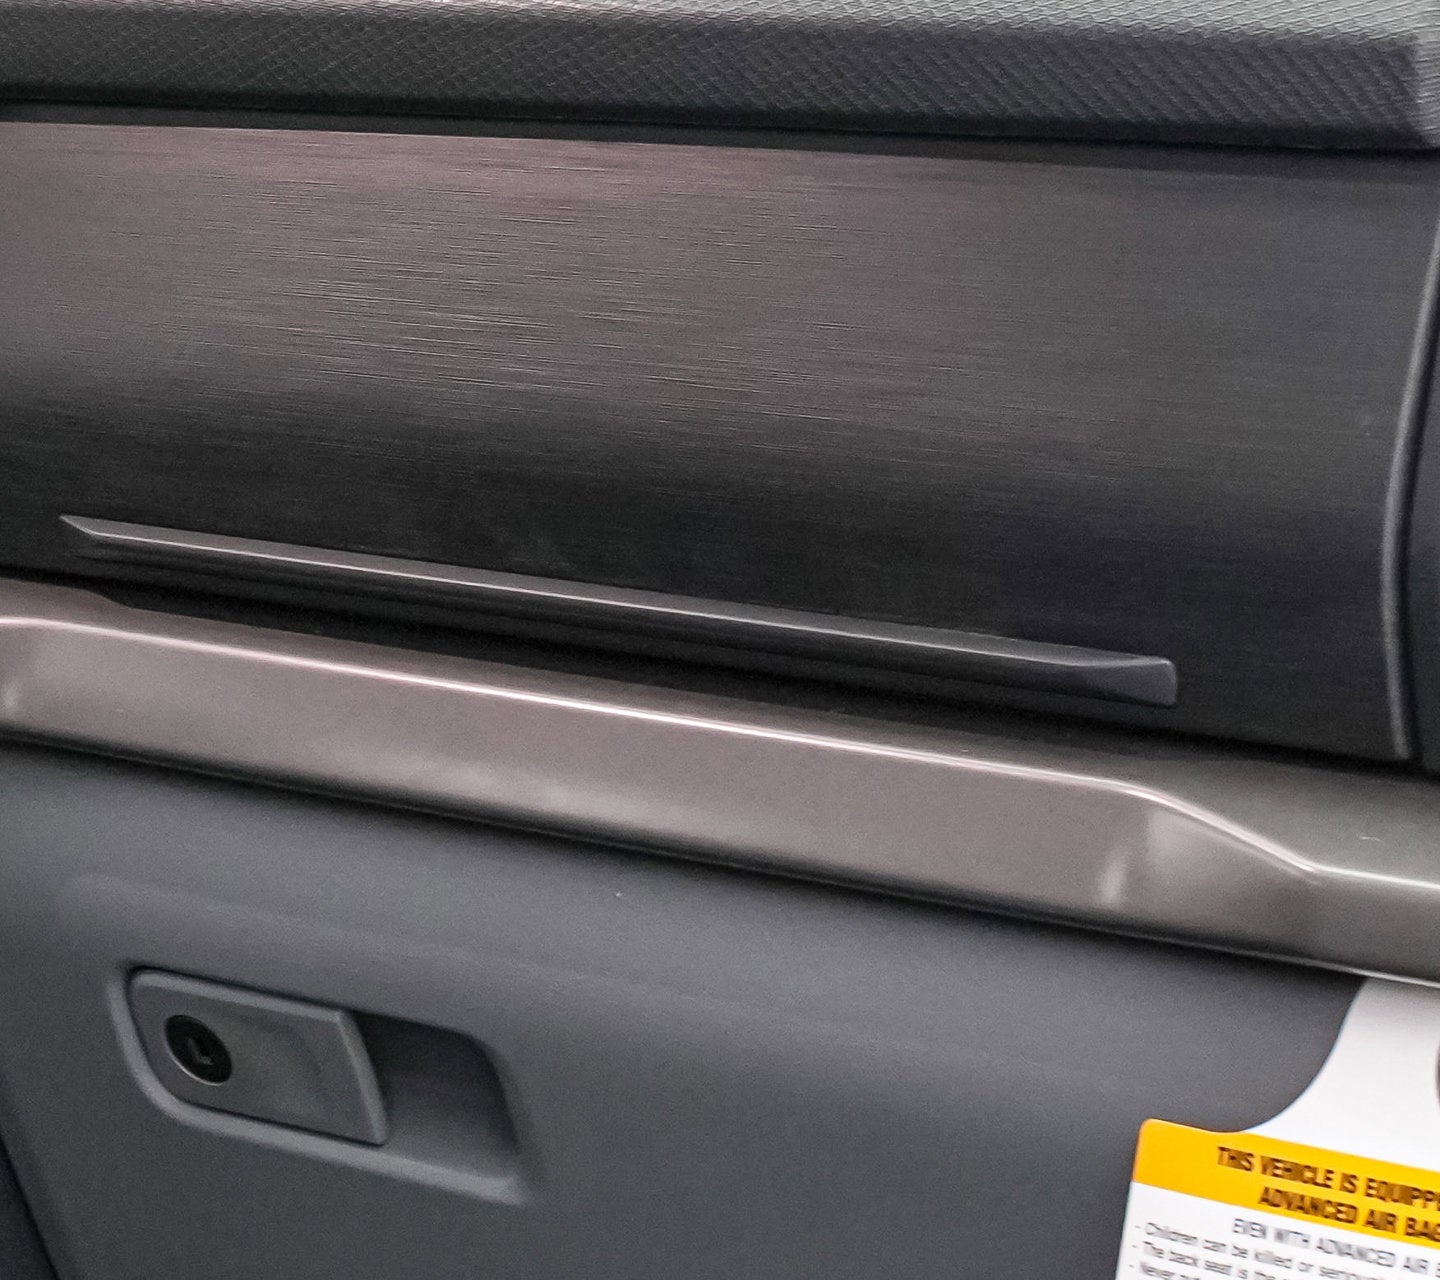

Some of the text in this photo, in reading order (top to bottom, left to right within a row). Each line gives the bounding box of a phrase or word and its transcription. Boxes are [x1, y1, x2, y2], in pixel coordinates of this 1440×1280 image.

[1218, 1146, 1255, 1171] THIS
[1261, 1156, 1334, 1189] VEHICLE
[1340, 1173, 1359, 1194] IS
[1258, 1187, 1358, 1224] ADVANCED
[1366, 1209, 1397, 1233] AIR
[1143, 1222, 1198, 1245] Children
[1203, 1240, 1227, 1253] can
[1232, 1245, 1248, 1258] be
[1254, 1250, 1293, 1269] killed
[1297, 1262, 1314, 1273] or
[1143, 1241, 1164, 1259] The
[1168, 1251, 1199, 1267] back
[1203, 1260, 1232, 1276] seat
[1237, 1269, 1248, 1280] is
[1233, 1218, 1267, 1239] EVEN
[1274, 1228, 1310, 1248] WITH
[1316, 1238, 1396, 1267] ADVANCED
[1403, 1257, 1429, 1273] AIR
[1140, 1262, 1176, 1280] Never
